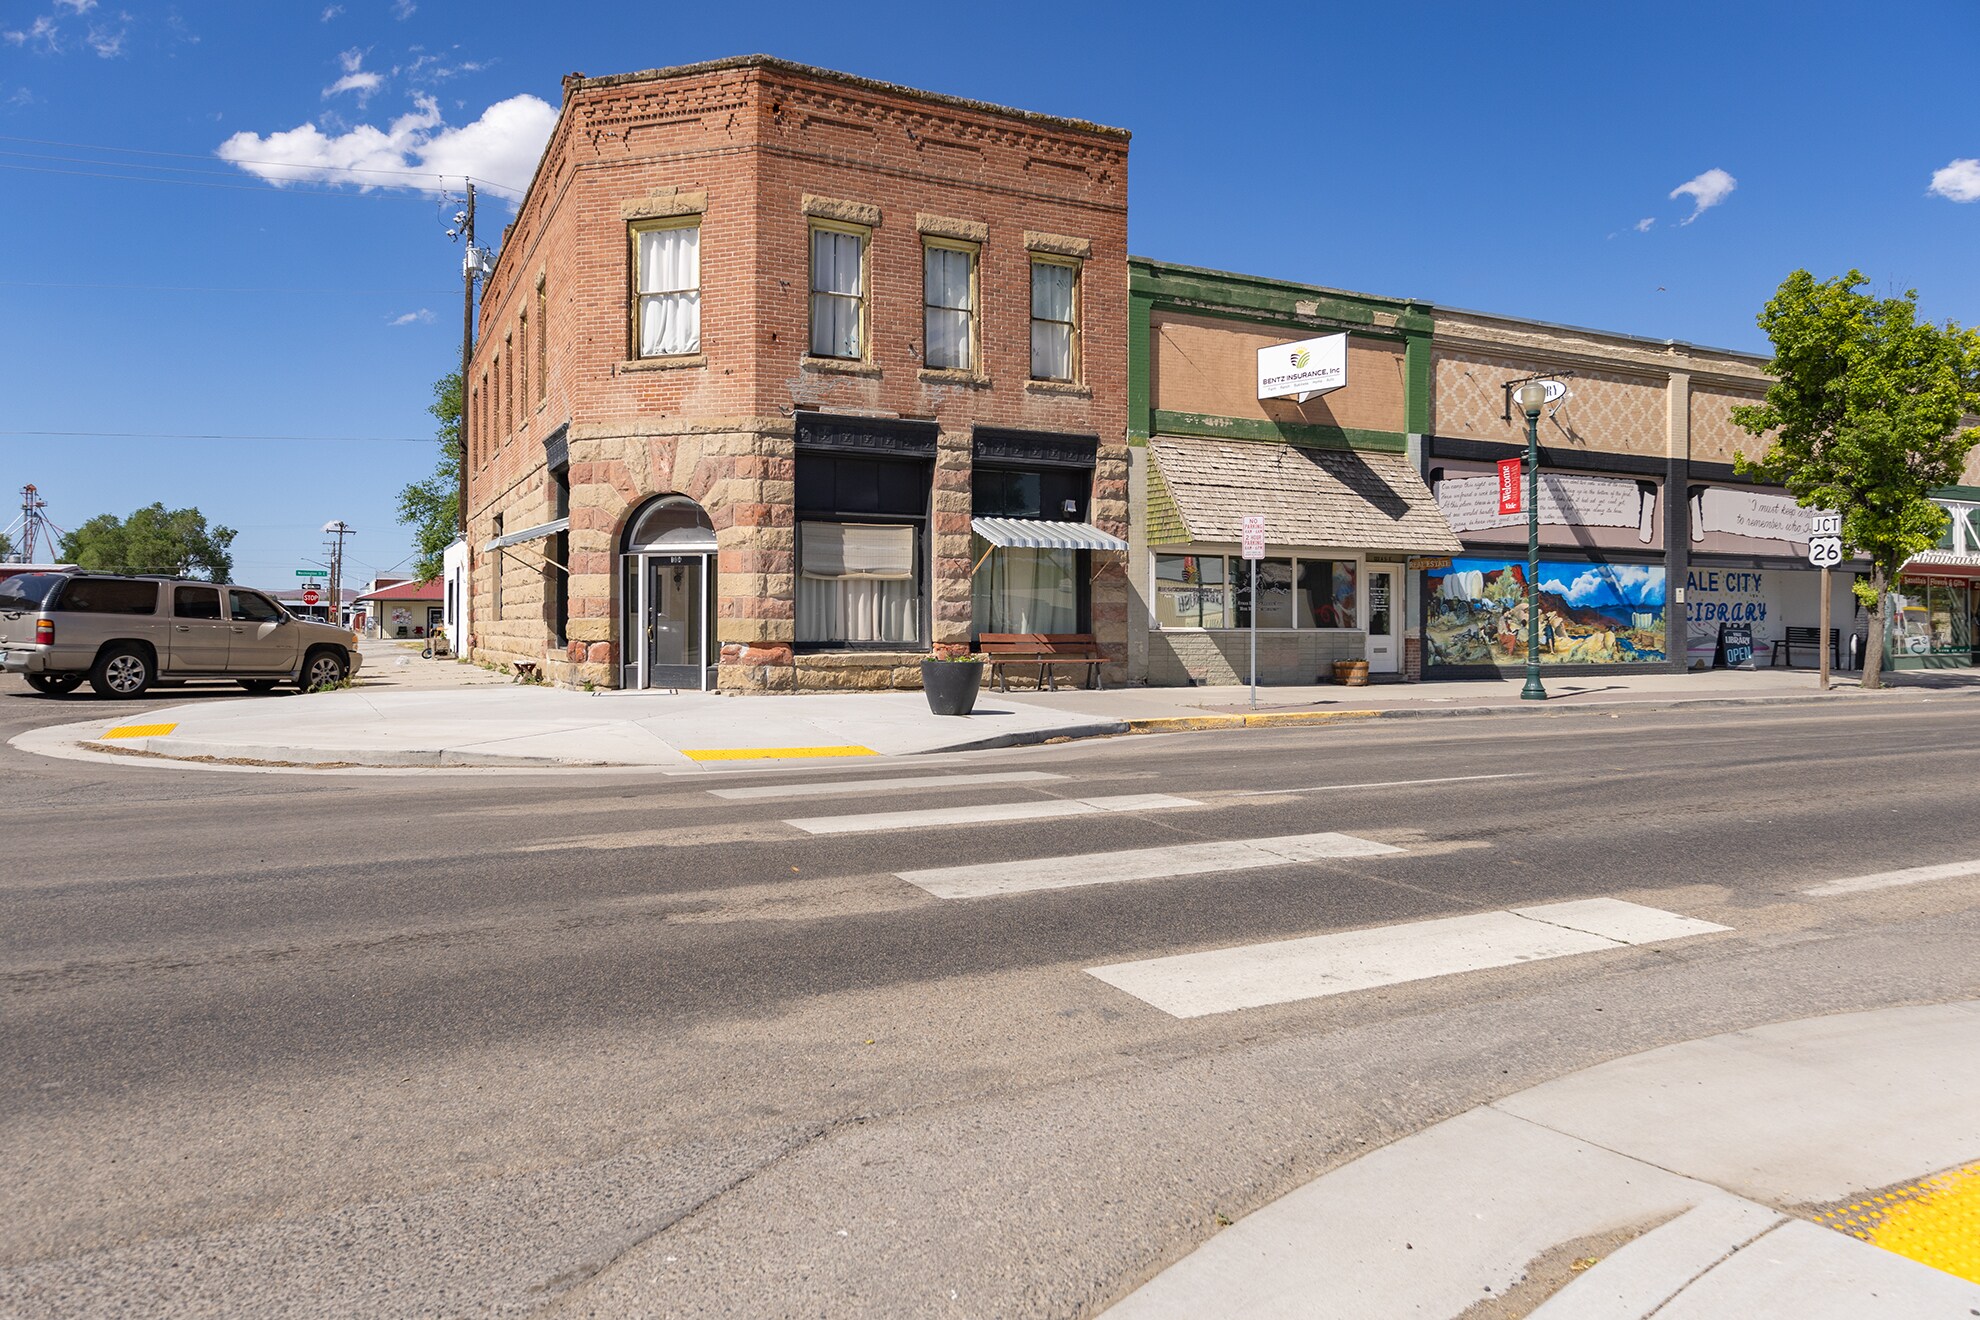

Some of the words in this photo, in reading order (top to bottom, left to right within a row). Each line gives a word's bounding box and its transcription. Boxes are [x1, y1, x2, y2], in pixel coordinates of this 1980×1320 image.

[1263, 376, 1285, 385] BENTZ
[1287, 368, 1328, 381] INSURANCE,
[1502, 465, 1512, 502] Welcome
[1760, 503, 1779, 514] must
[1781, 504, 1796, 518] keep
[1737, 513, 1744, 524] to
[1746, 517, 1784, 530] remember
[1785, 521, 1801, 532] who
[1813, 518, 1838, 532] JCT
[1813, 543, 1839, 561] 26
[1409, 560, 1425, 568] REAL
[1426, 559, 1450, 568] ESTATE
[1687, 571, 1719, 592] ALE
[1725, 572, 1761, 592] CITY
[1725, 636, 1751, 645] LIBRARY
[1727, 646, 1752, 662] OPEN
